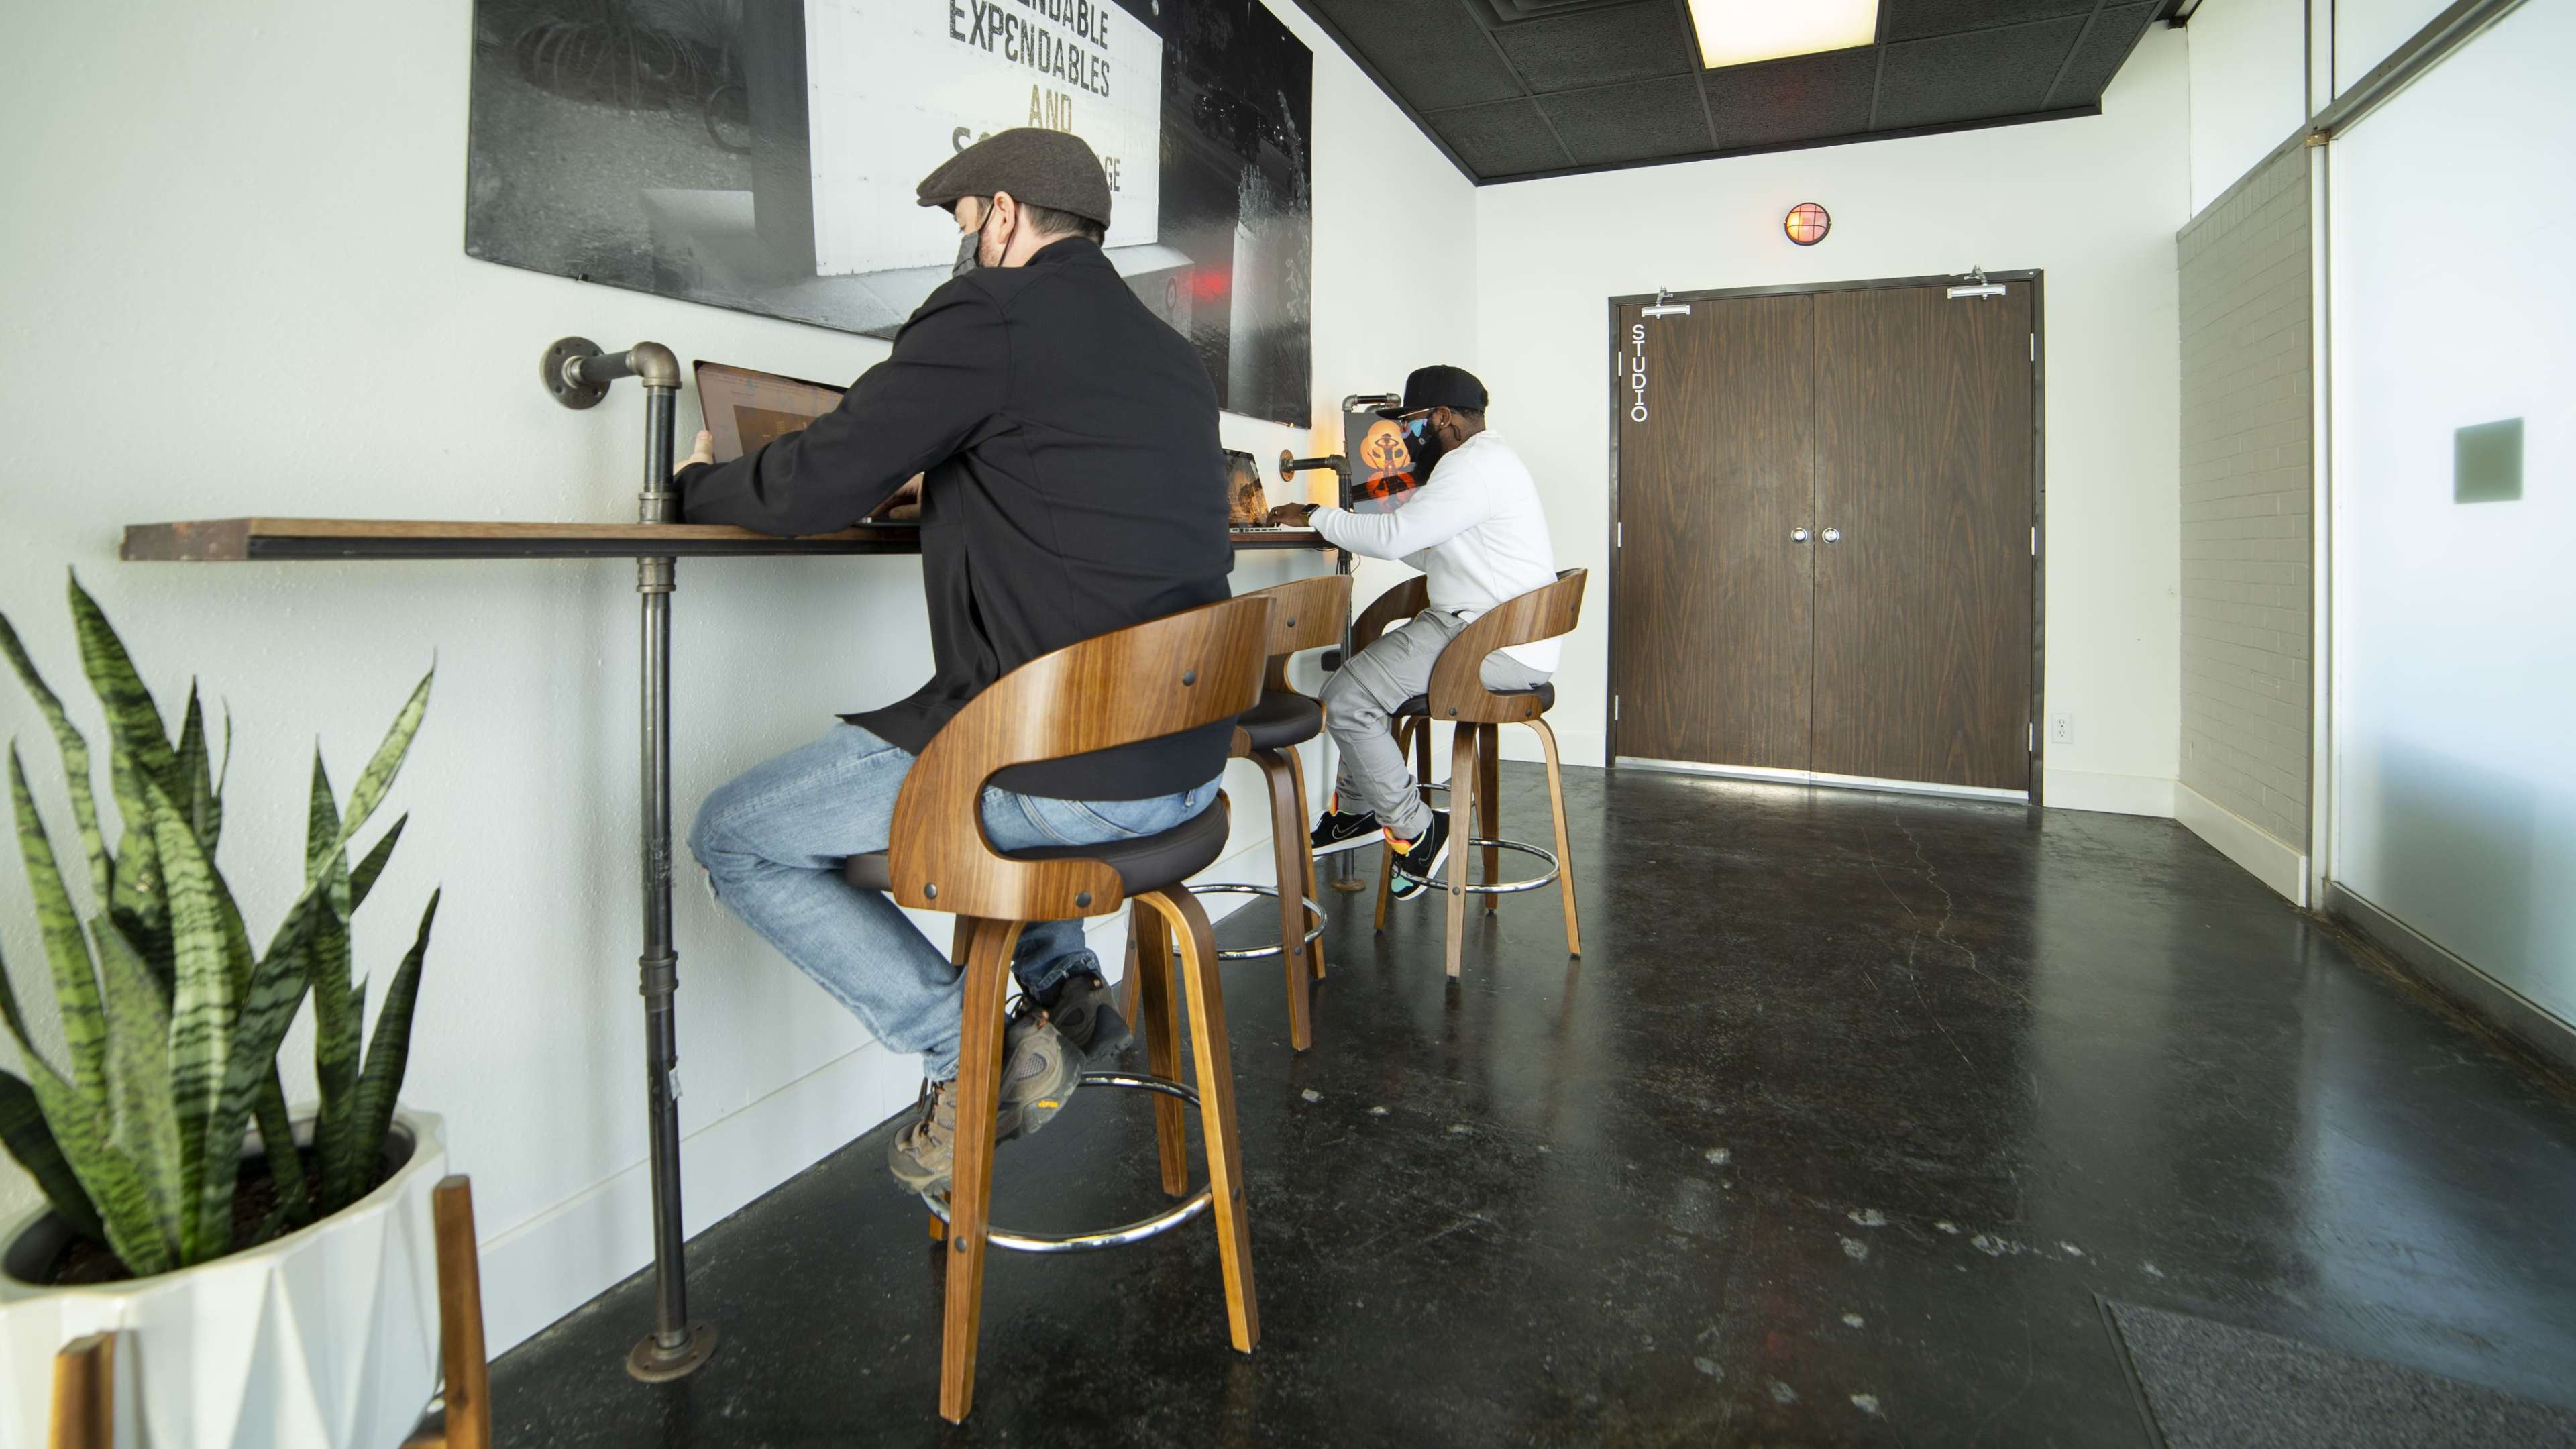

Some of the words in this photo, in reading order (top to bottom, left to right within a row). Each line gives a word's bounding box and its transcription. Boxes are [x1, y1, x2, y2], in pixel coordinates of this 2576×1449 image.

[949, 0, 1110, 97] EXPENDABLES
[1016, 0, 1108, 50] DABLE
[1028, 84, 1071, 133] AND
[1631, 323, 1648, 422] STUDIO
